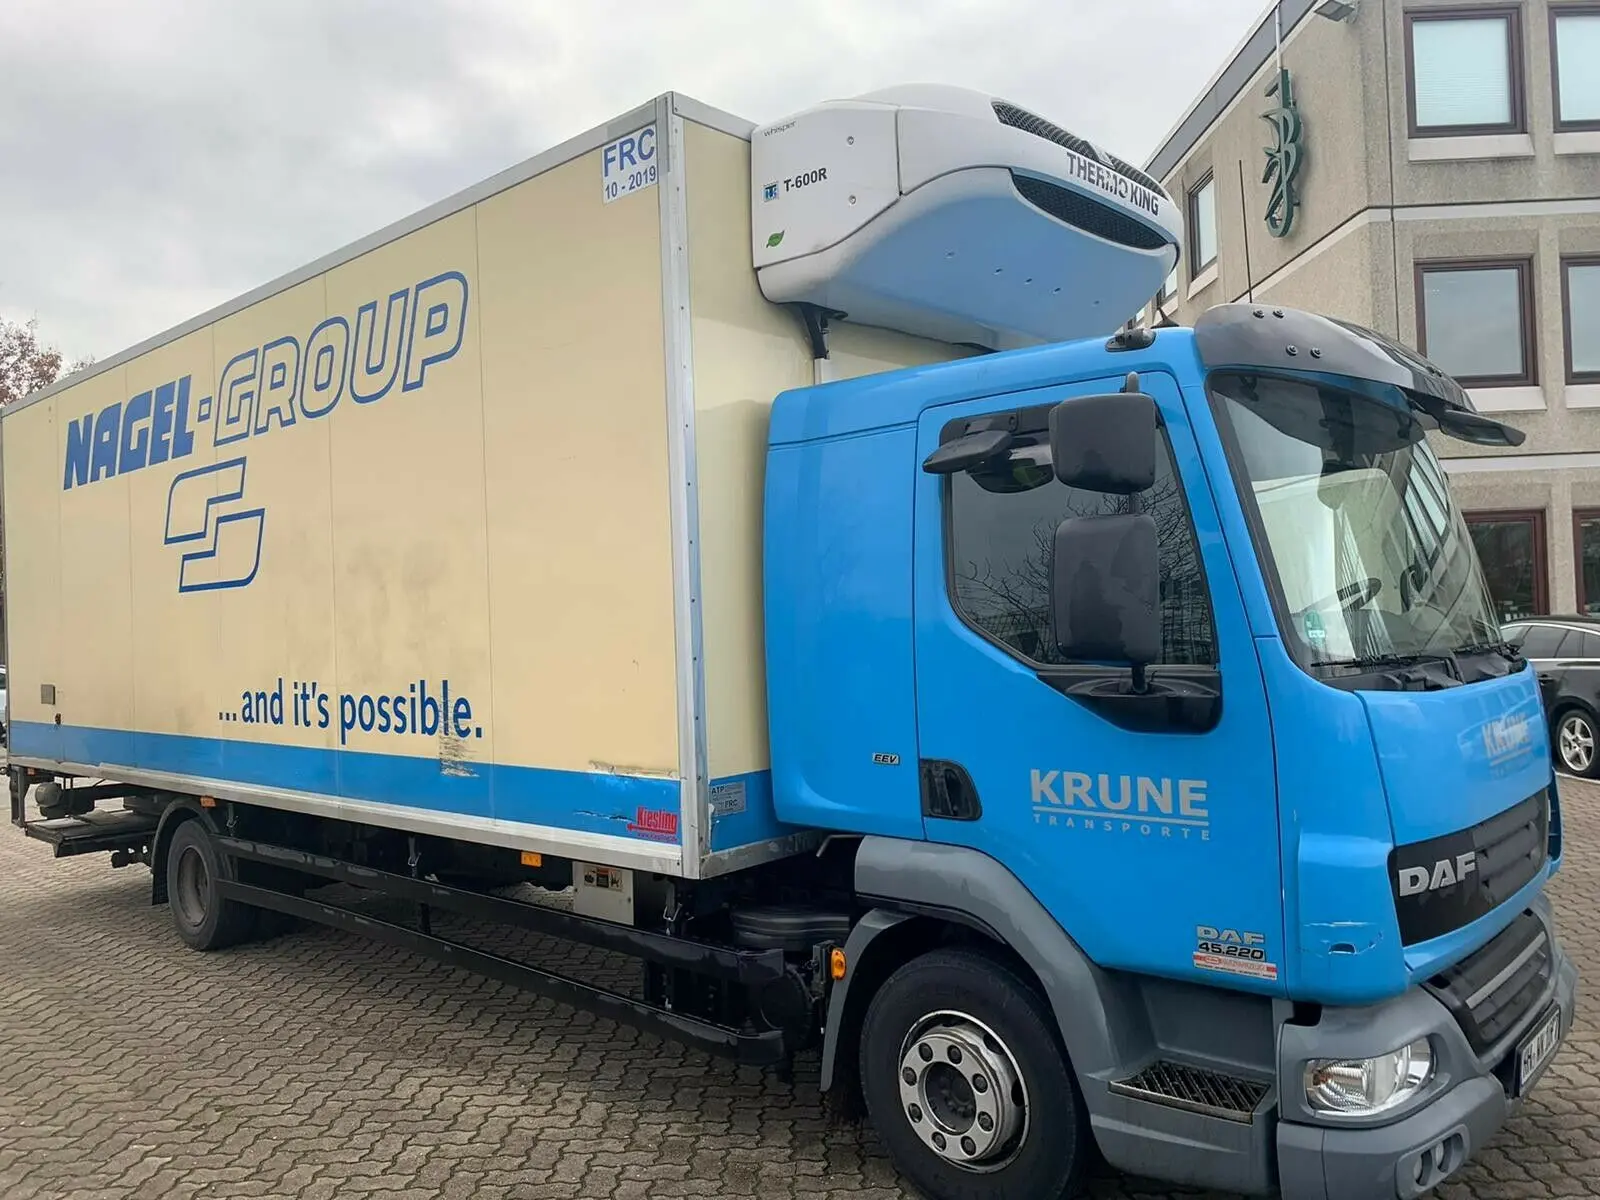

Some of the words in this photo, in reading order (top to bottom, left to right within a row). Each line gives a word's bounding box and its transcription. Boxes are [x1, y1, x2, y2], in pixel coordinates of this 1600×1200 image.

[763, 120, 797, 138] whisper
[603, 128, 656, 178] FRC
[605, 181, 618, 200] 10
[628, 165, 657, 191] 2019
[783, 166, 828, 193] T-600R
[1130, 183, 1159, 216] KING
[63, 270, 469, 491] NAGEL-GROUP
[293, 681, 330, 729] it's
[340, 679, 483, 745] possible.
[873, 753, 898, 763] EEV
[711, 785, 725, 795] ATP
[1030, 768, 1209, 817] KRUNE
[637, 806, 678, 833] Kiesling
[1033, 813, 1210, 841] TRANSPORTE
[1398, 851, 1476, 897] DAF
[1196, 925, 1265, 945] DAF
[1199, 942, 1264, 960] 45.220
